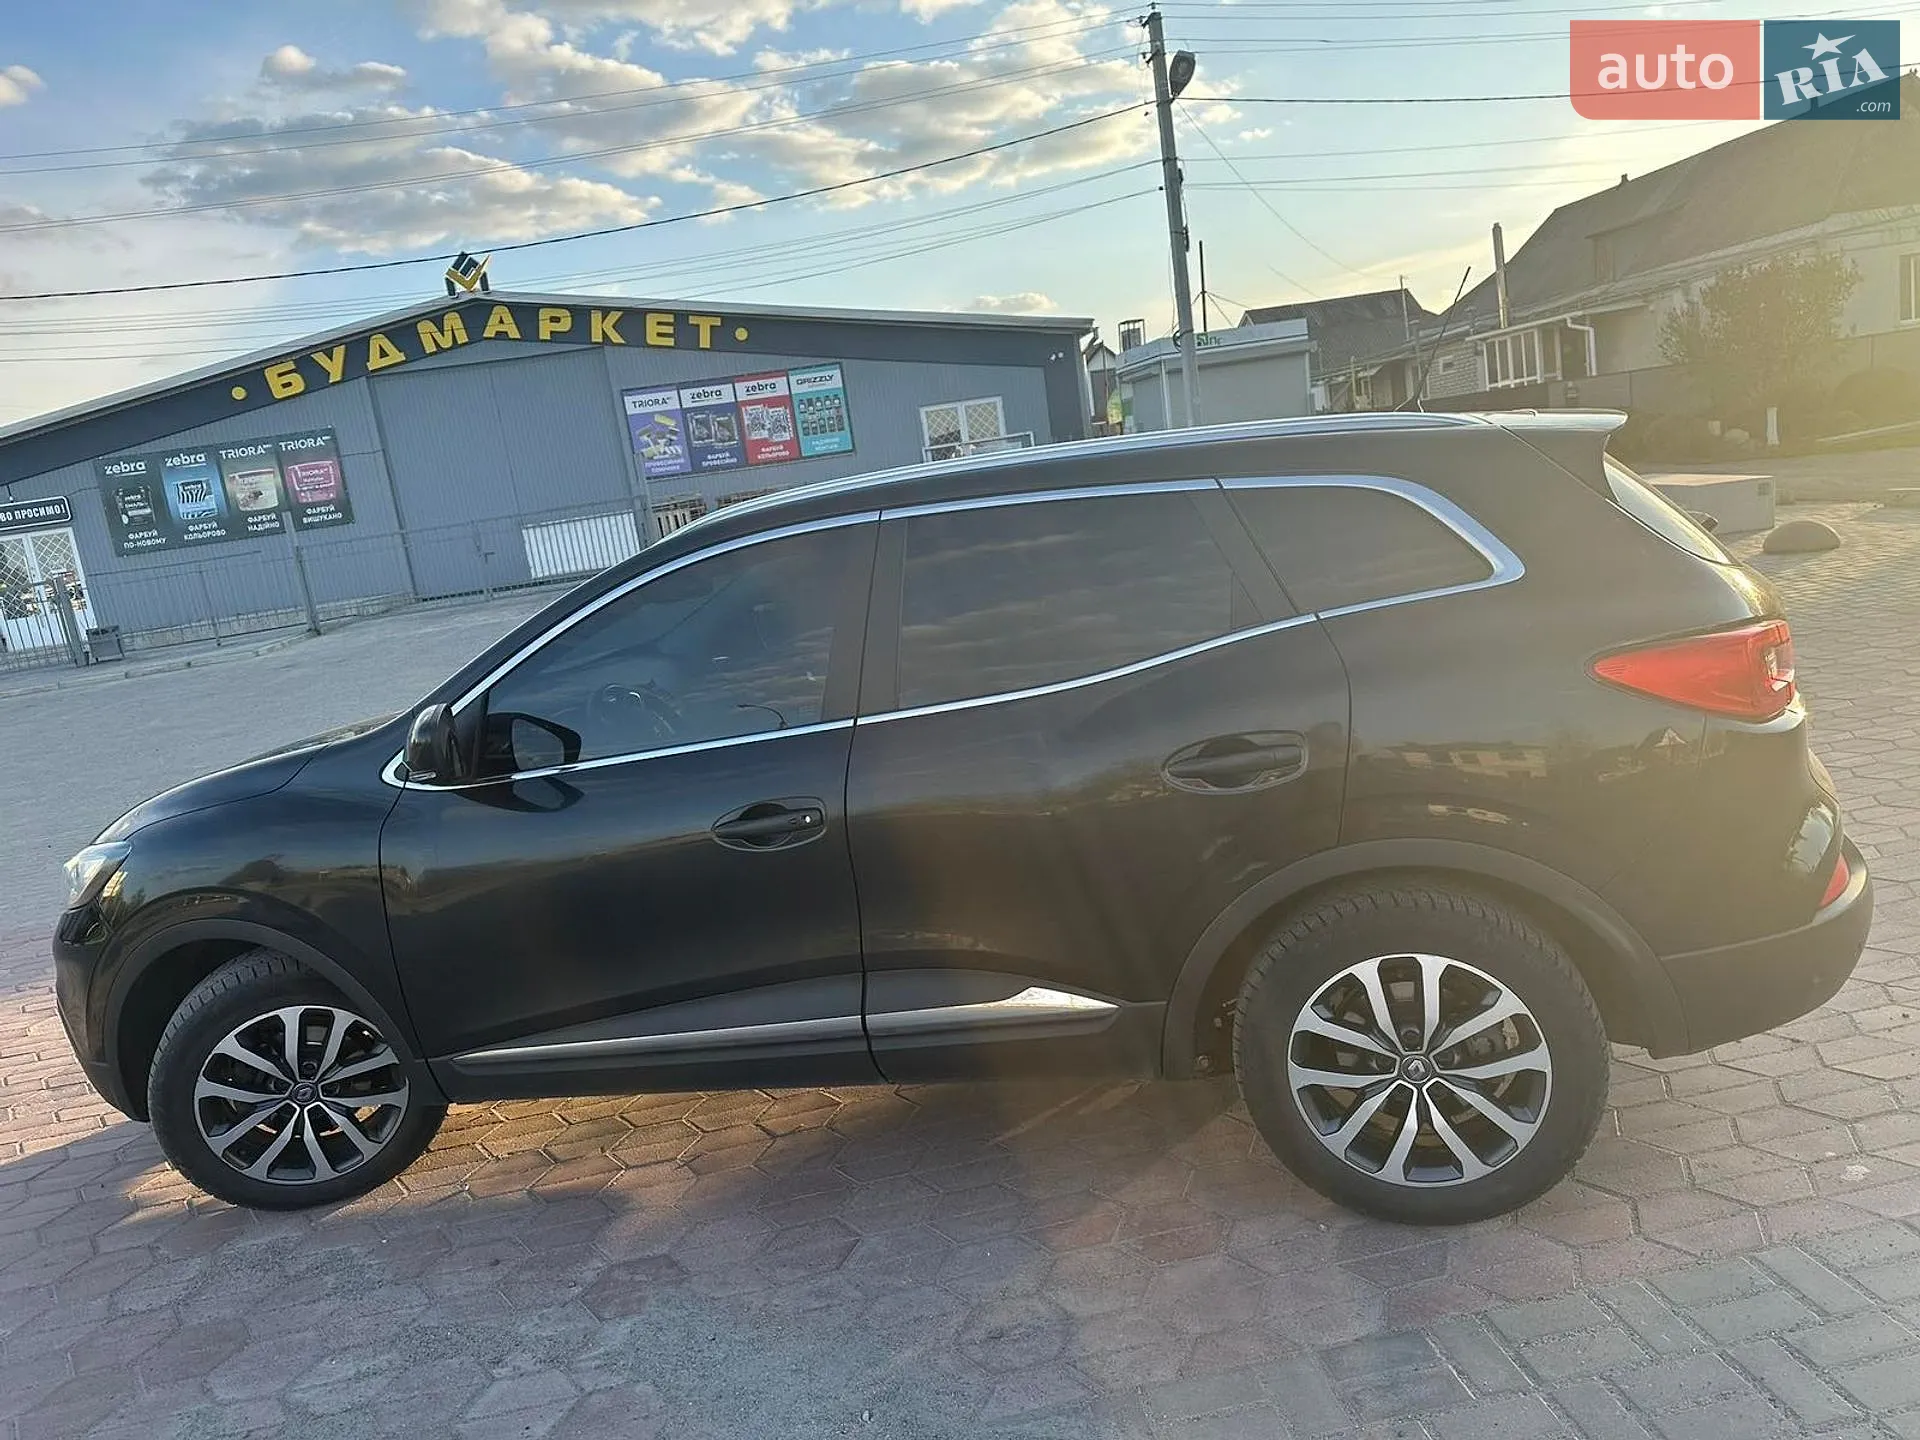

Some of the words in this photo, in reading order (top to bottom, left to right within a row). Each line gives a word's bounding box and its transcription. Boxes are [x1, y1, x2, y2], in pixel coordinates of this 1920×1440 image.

[262, 304, 722, 400] БУДМАРКЕТ
[796, 374, 834, 385] GRIZZLY
[745, 381, 777, 393] zebra
[690, 389, 723, 400] zebra
[632, 397, 668, 409] TRIORA
[280, 438, 325, 452] TRIORA
[219, 445, 266, 460] TRIORA
[165, 453, 206, 467] zebra
[104, 461, 146, 475] zebra
[14, 503, 66, 520] ПРОСИМО!
[306, 504, 336, 515] ФАРБУЙ
[247, 513, 277, 524] ФАРБУЙ
[302, 512, 343, 524] ВИШУКАНО
[188, 521, 218, 532] ФАРБУЙ
[128, 529, 158, 540] ФАРБУЙ
[183, 529, 226, 541] КОЛЬОРОВО
[123, 537, 166, 549] ПО-НОВОМУ
